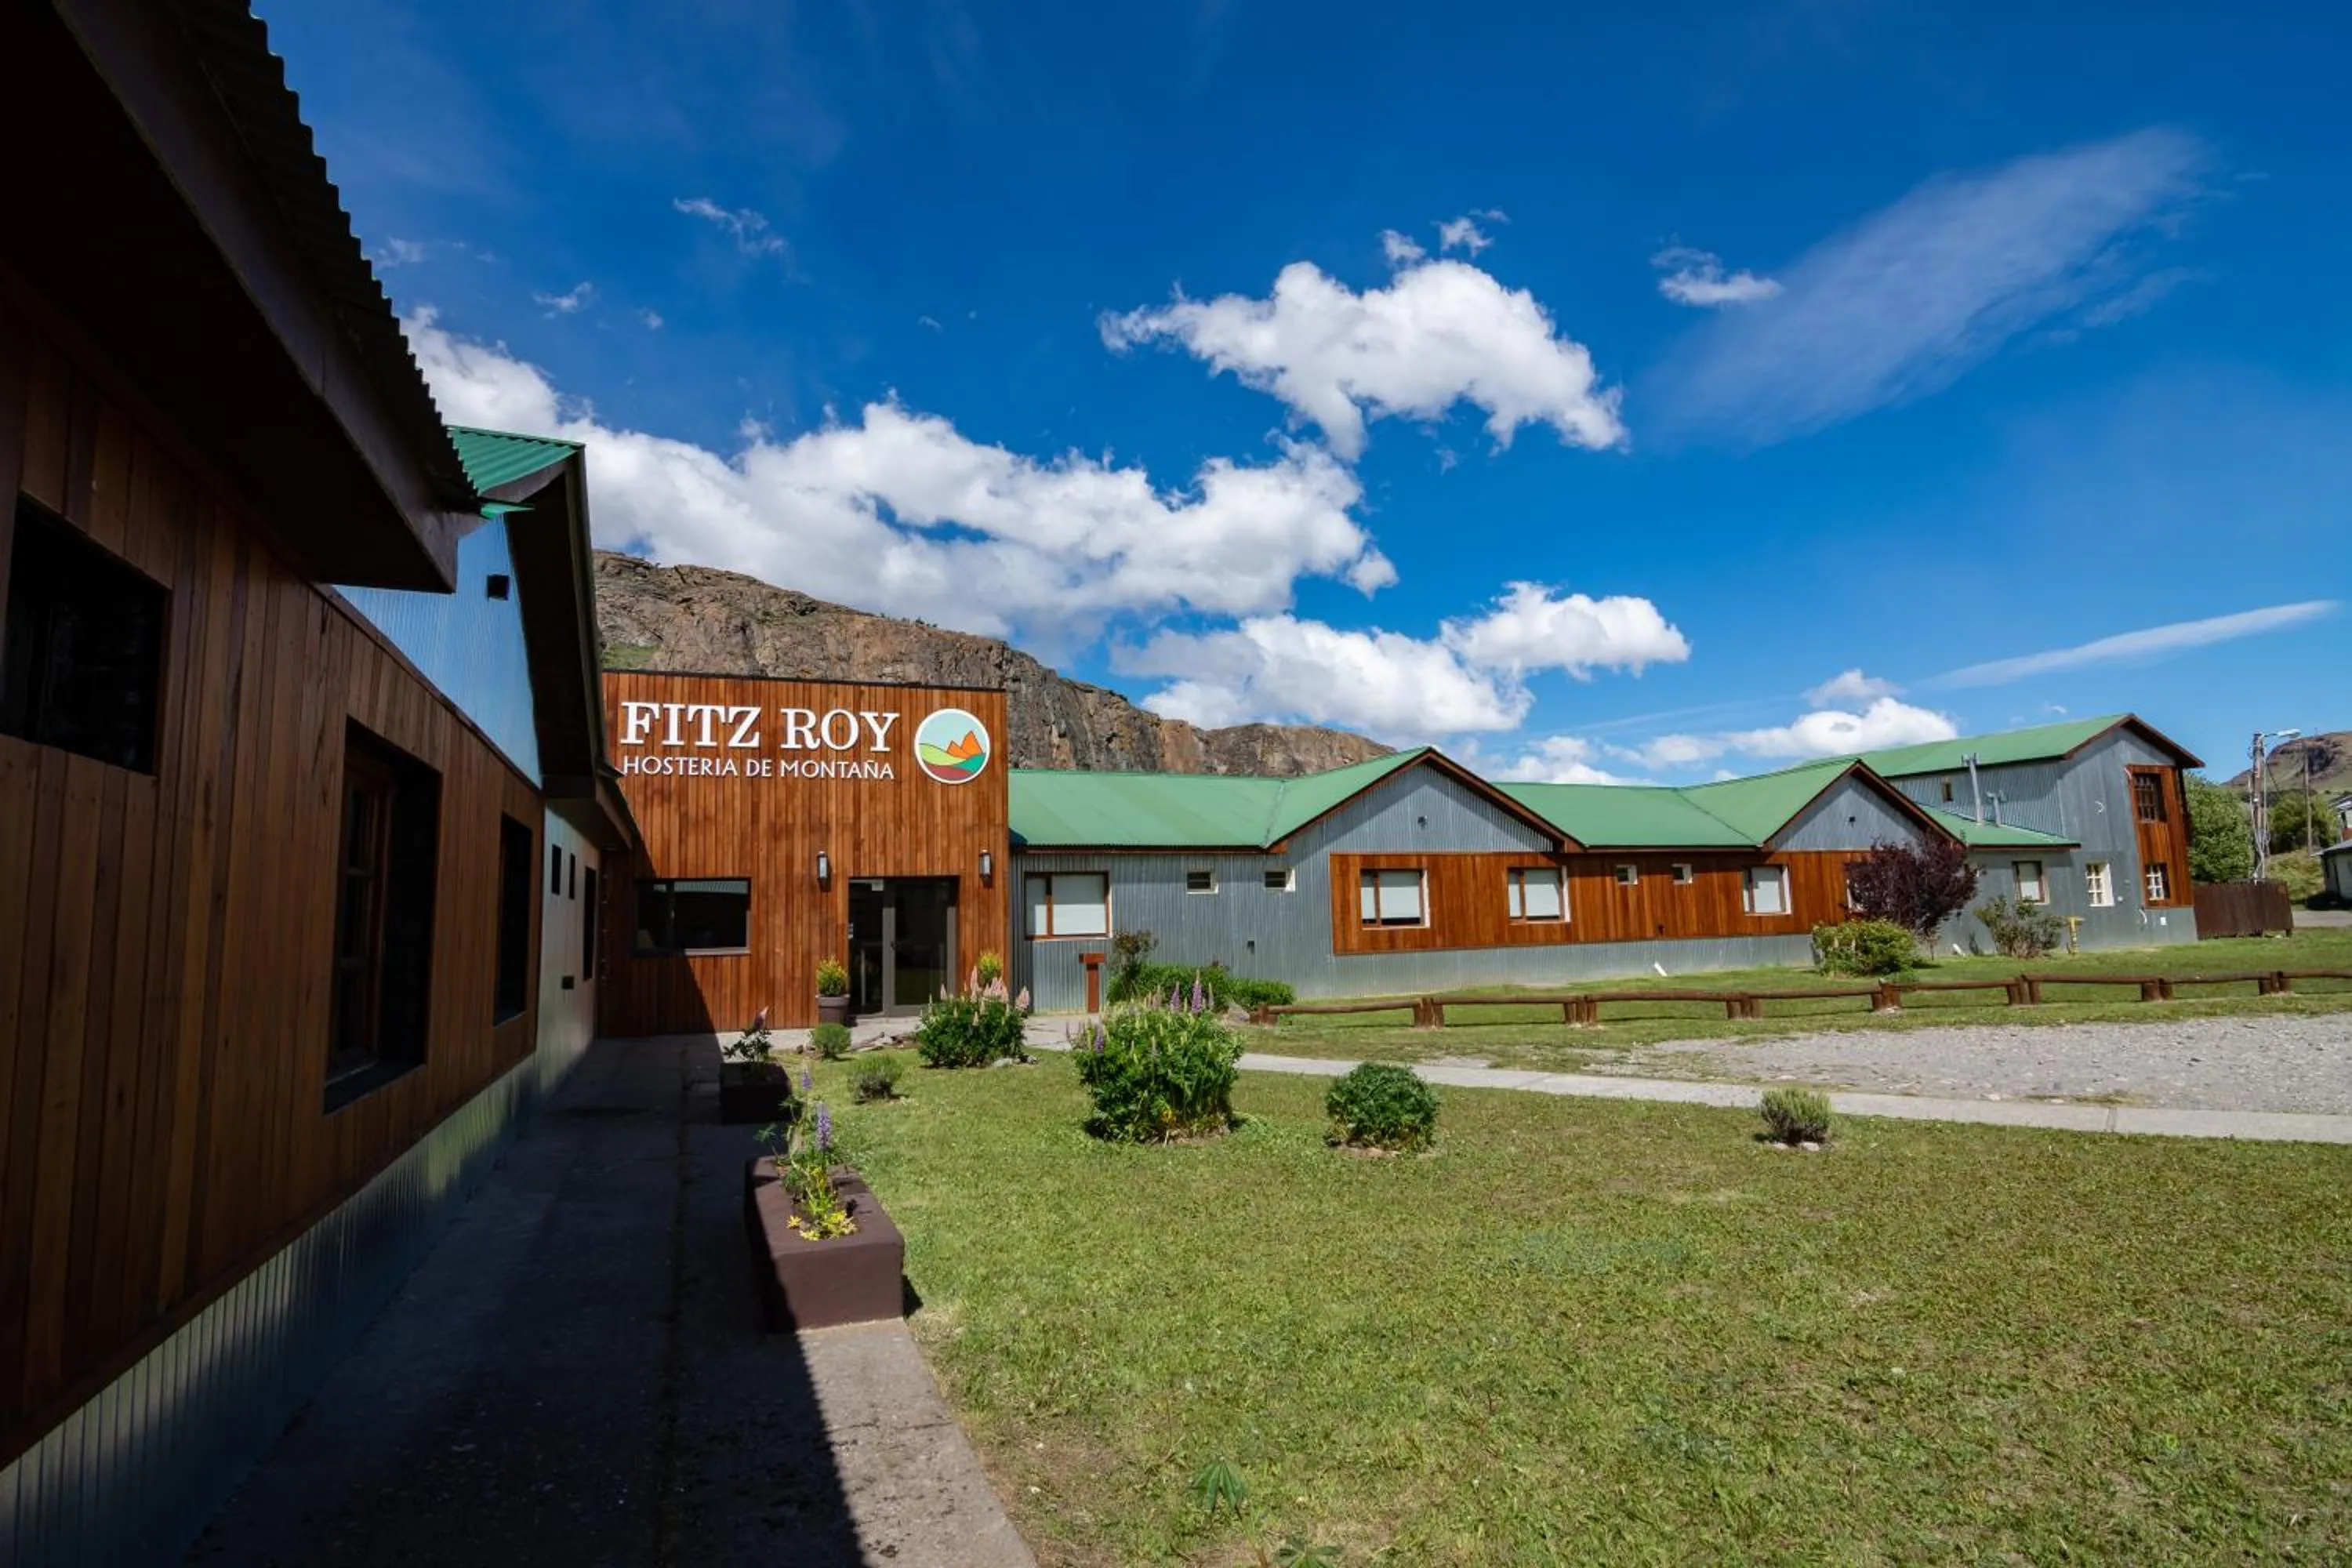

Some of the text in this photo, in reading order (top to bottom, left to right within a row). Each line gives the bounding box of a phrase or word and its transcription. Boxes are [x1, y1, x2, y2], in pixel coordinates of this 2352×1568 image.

[620, 701, 899, 752] FITZ ROY
[622, 756, 895, 779] HOSTERIA DE MONTAÑA
